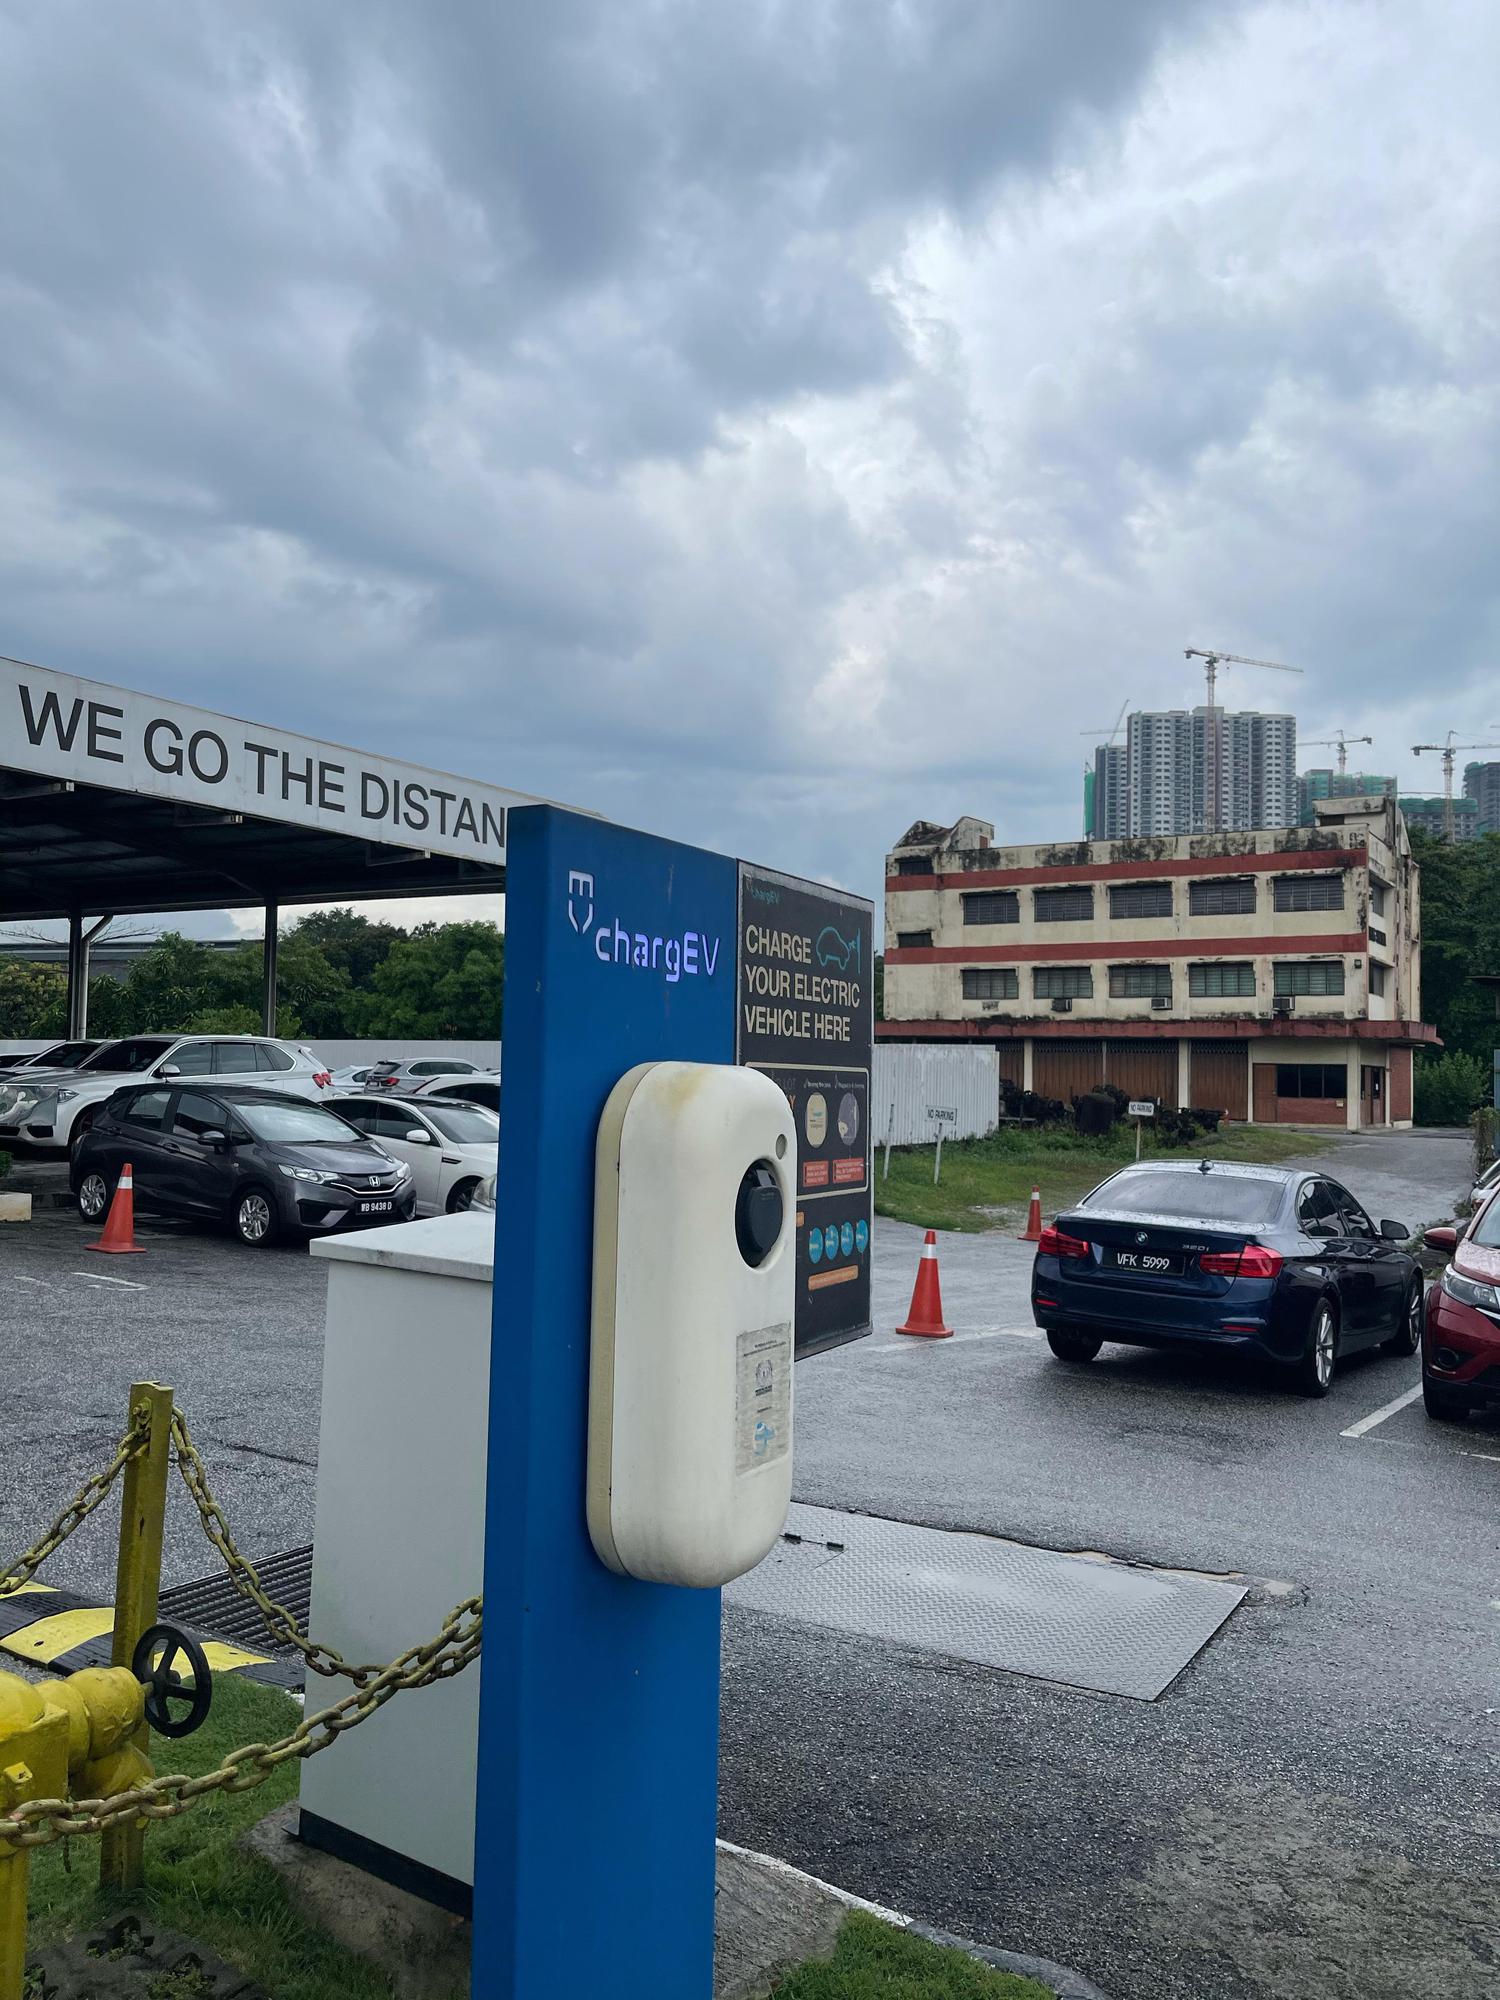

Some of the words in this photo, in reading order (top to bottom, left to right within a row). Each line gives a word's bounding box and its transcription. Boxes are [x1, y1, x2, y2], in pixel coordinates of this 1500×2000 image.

[18, 684, 124, 763] WE
[143, 718, 229, 784] GO
[244, 741, 346, 813] THE
[361, 771, 505, 848] DISTAN
[595, 917, 720, 983] chargEV
[745, 924, 812, 964] CHARGE
[745, 964, 791, 998] YOUR
[794, 973, 860, 1008] ELECTRIC
[744, 1004, 811, 1038] VEHICLE
[814, 1013, 851, 1042] HERE
[370, 1202, 387, 1211] 9438
[1117, 1252, 1138, 1267] VFK
[1142, 1255, 1170, 1269] 5999
